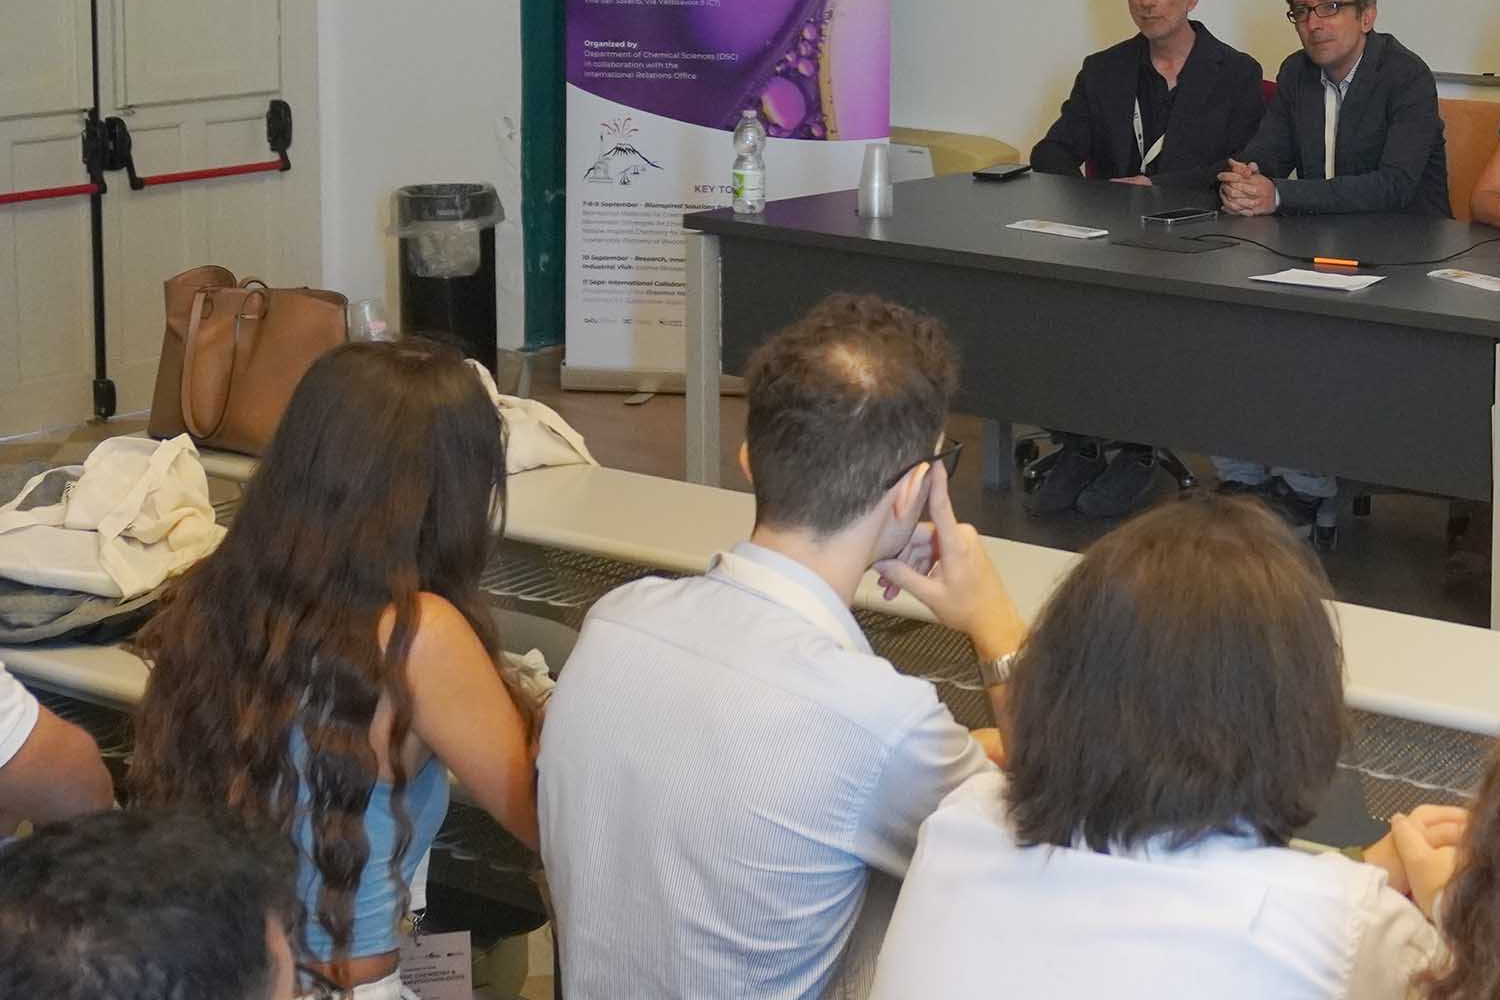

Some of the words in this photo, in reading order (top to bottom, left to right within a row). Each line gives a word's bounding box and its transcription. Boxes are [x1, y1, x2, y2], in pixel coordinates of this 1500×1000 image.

[584, 39, 626, 49] Organized
[627, 40, 638, 50] by
[694, 184, 716, 194] KEY
